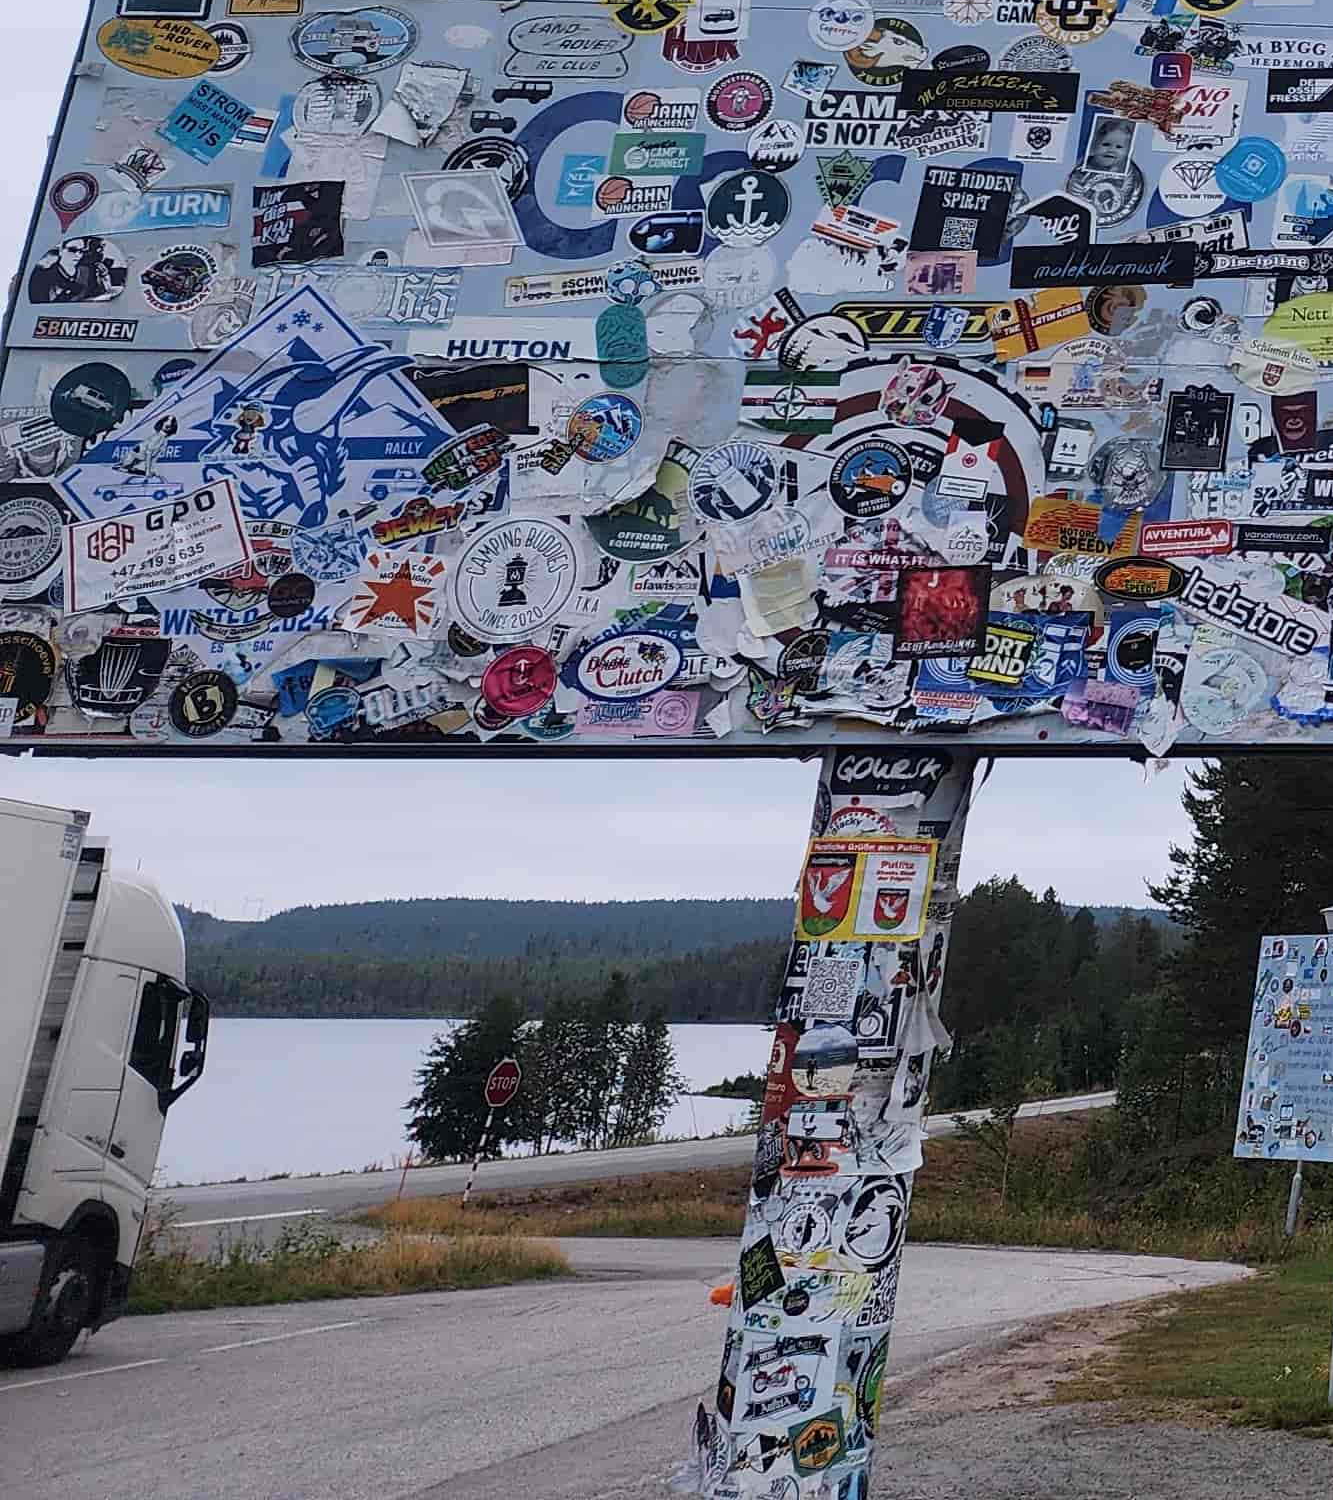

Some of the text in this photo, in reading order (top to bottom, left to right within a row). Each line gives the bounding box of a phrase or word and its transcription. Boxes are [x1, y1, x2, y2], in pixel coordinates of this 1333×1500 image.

[652, 104, 696, 121] JAHN
[808, 124, 875, 145] IS NOT
[1034, 258, 1172, 278] molekularmusik
[1212, 254, 1309, 271] Discipline
[1292, 305, 1328, 322] Nett
[446, 339, 570, 358] HUTTON
[384, 442, 422, 455] RALLY
[618, 532, 665, 542] OFFROAD
[1145, 529, 1212, 541] AVVENTURA
[609, 540, 668, 551] EQUIPMENT
[1183, 569, 1318, 655] ledstore
[489, 1075, 517, 1091] STOP
